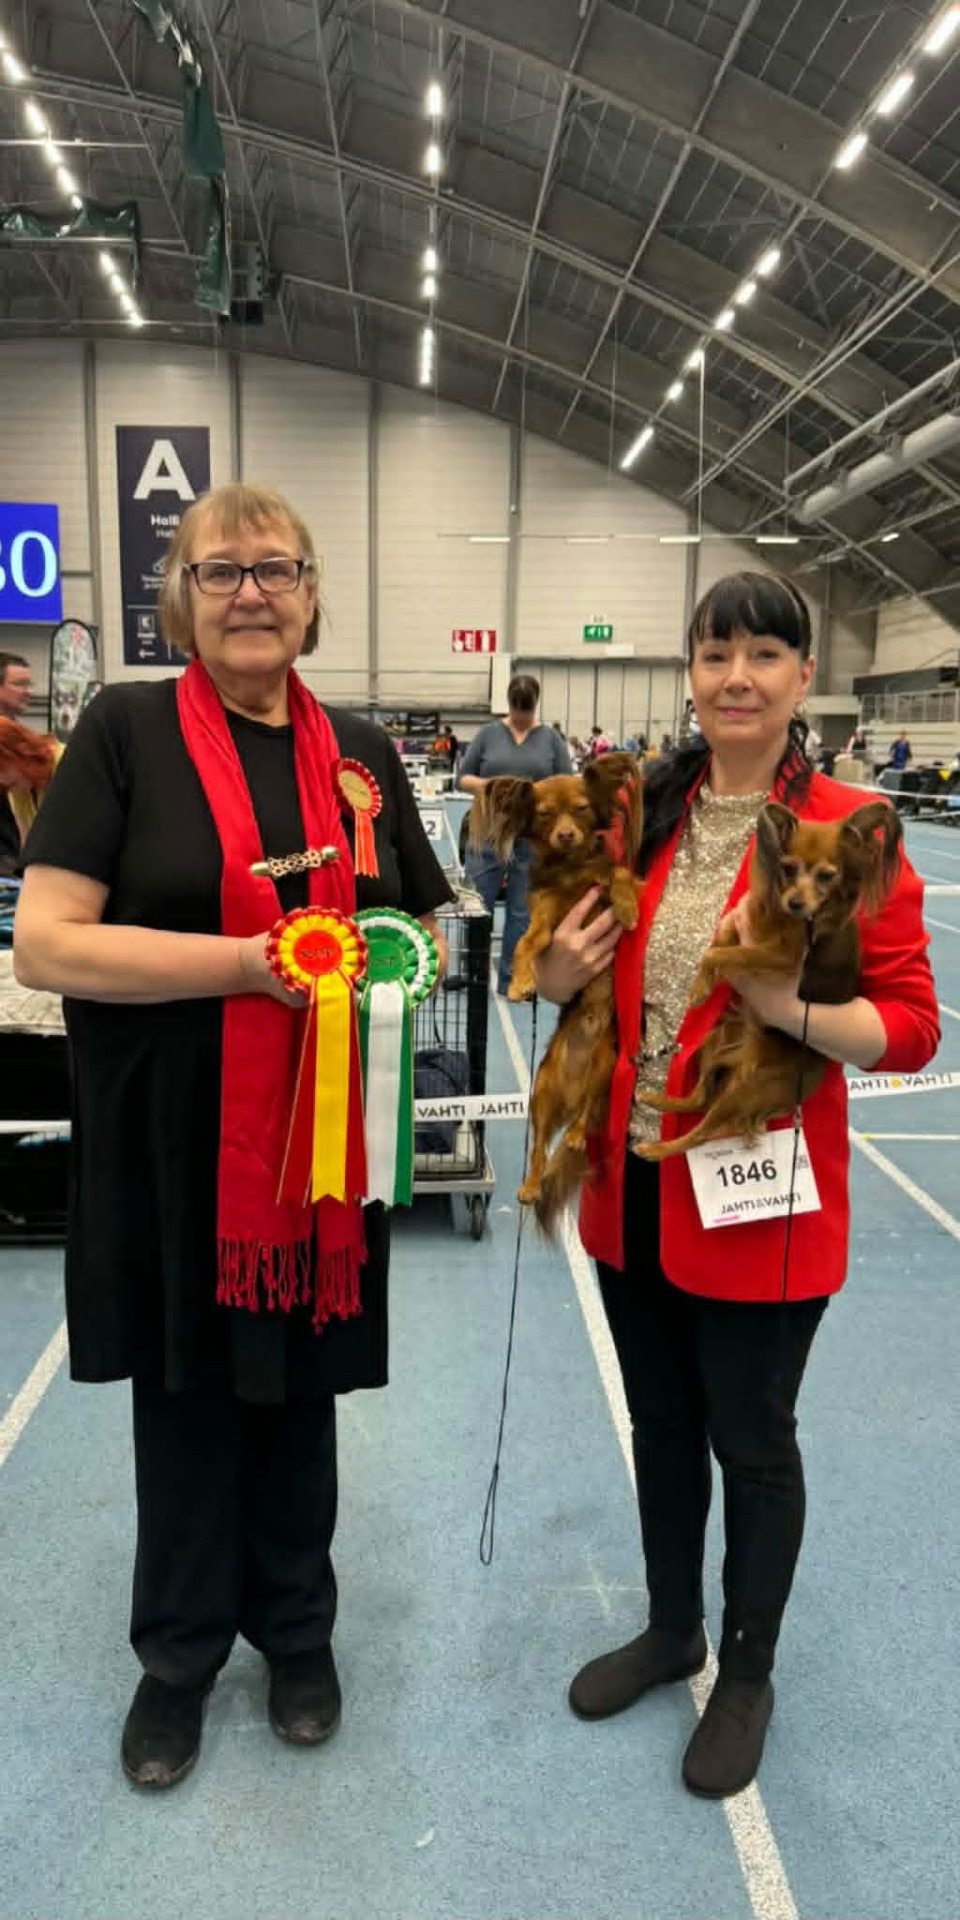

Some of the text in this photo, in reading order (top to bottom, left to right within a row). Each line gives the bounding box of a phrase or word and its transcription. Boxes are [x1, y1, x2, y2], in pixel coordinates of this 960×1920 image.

[133, 439, 195, 499] A
[0, 530, 57, 597] 0
[418, 1101, 524, 1118] VAHTI JAHTI
[716, 1159, 777, 1187] 1846
